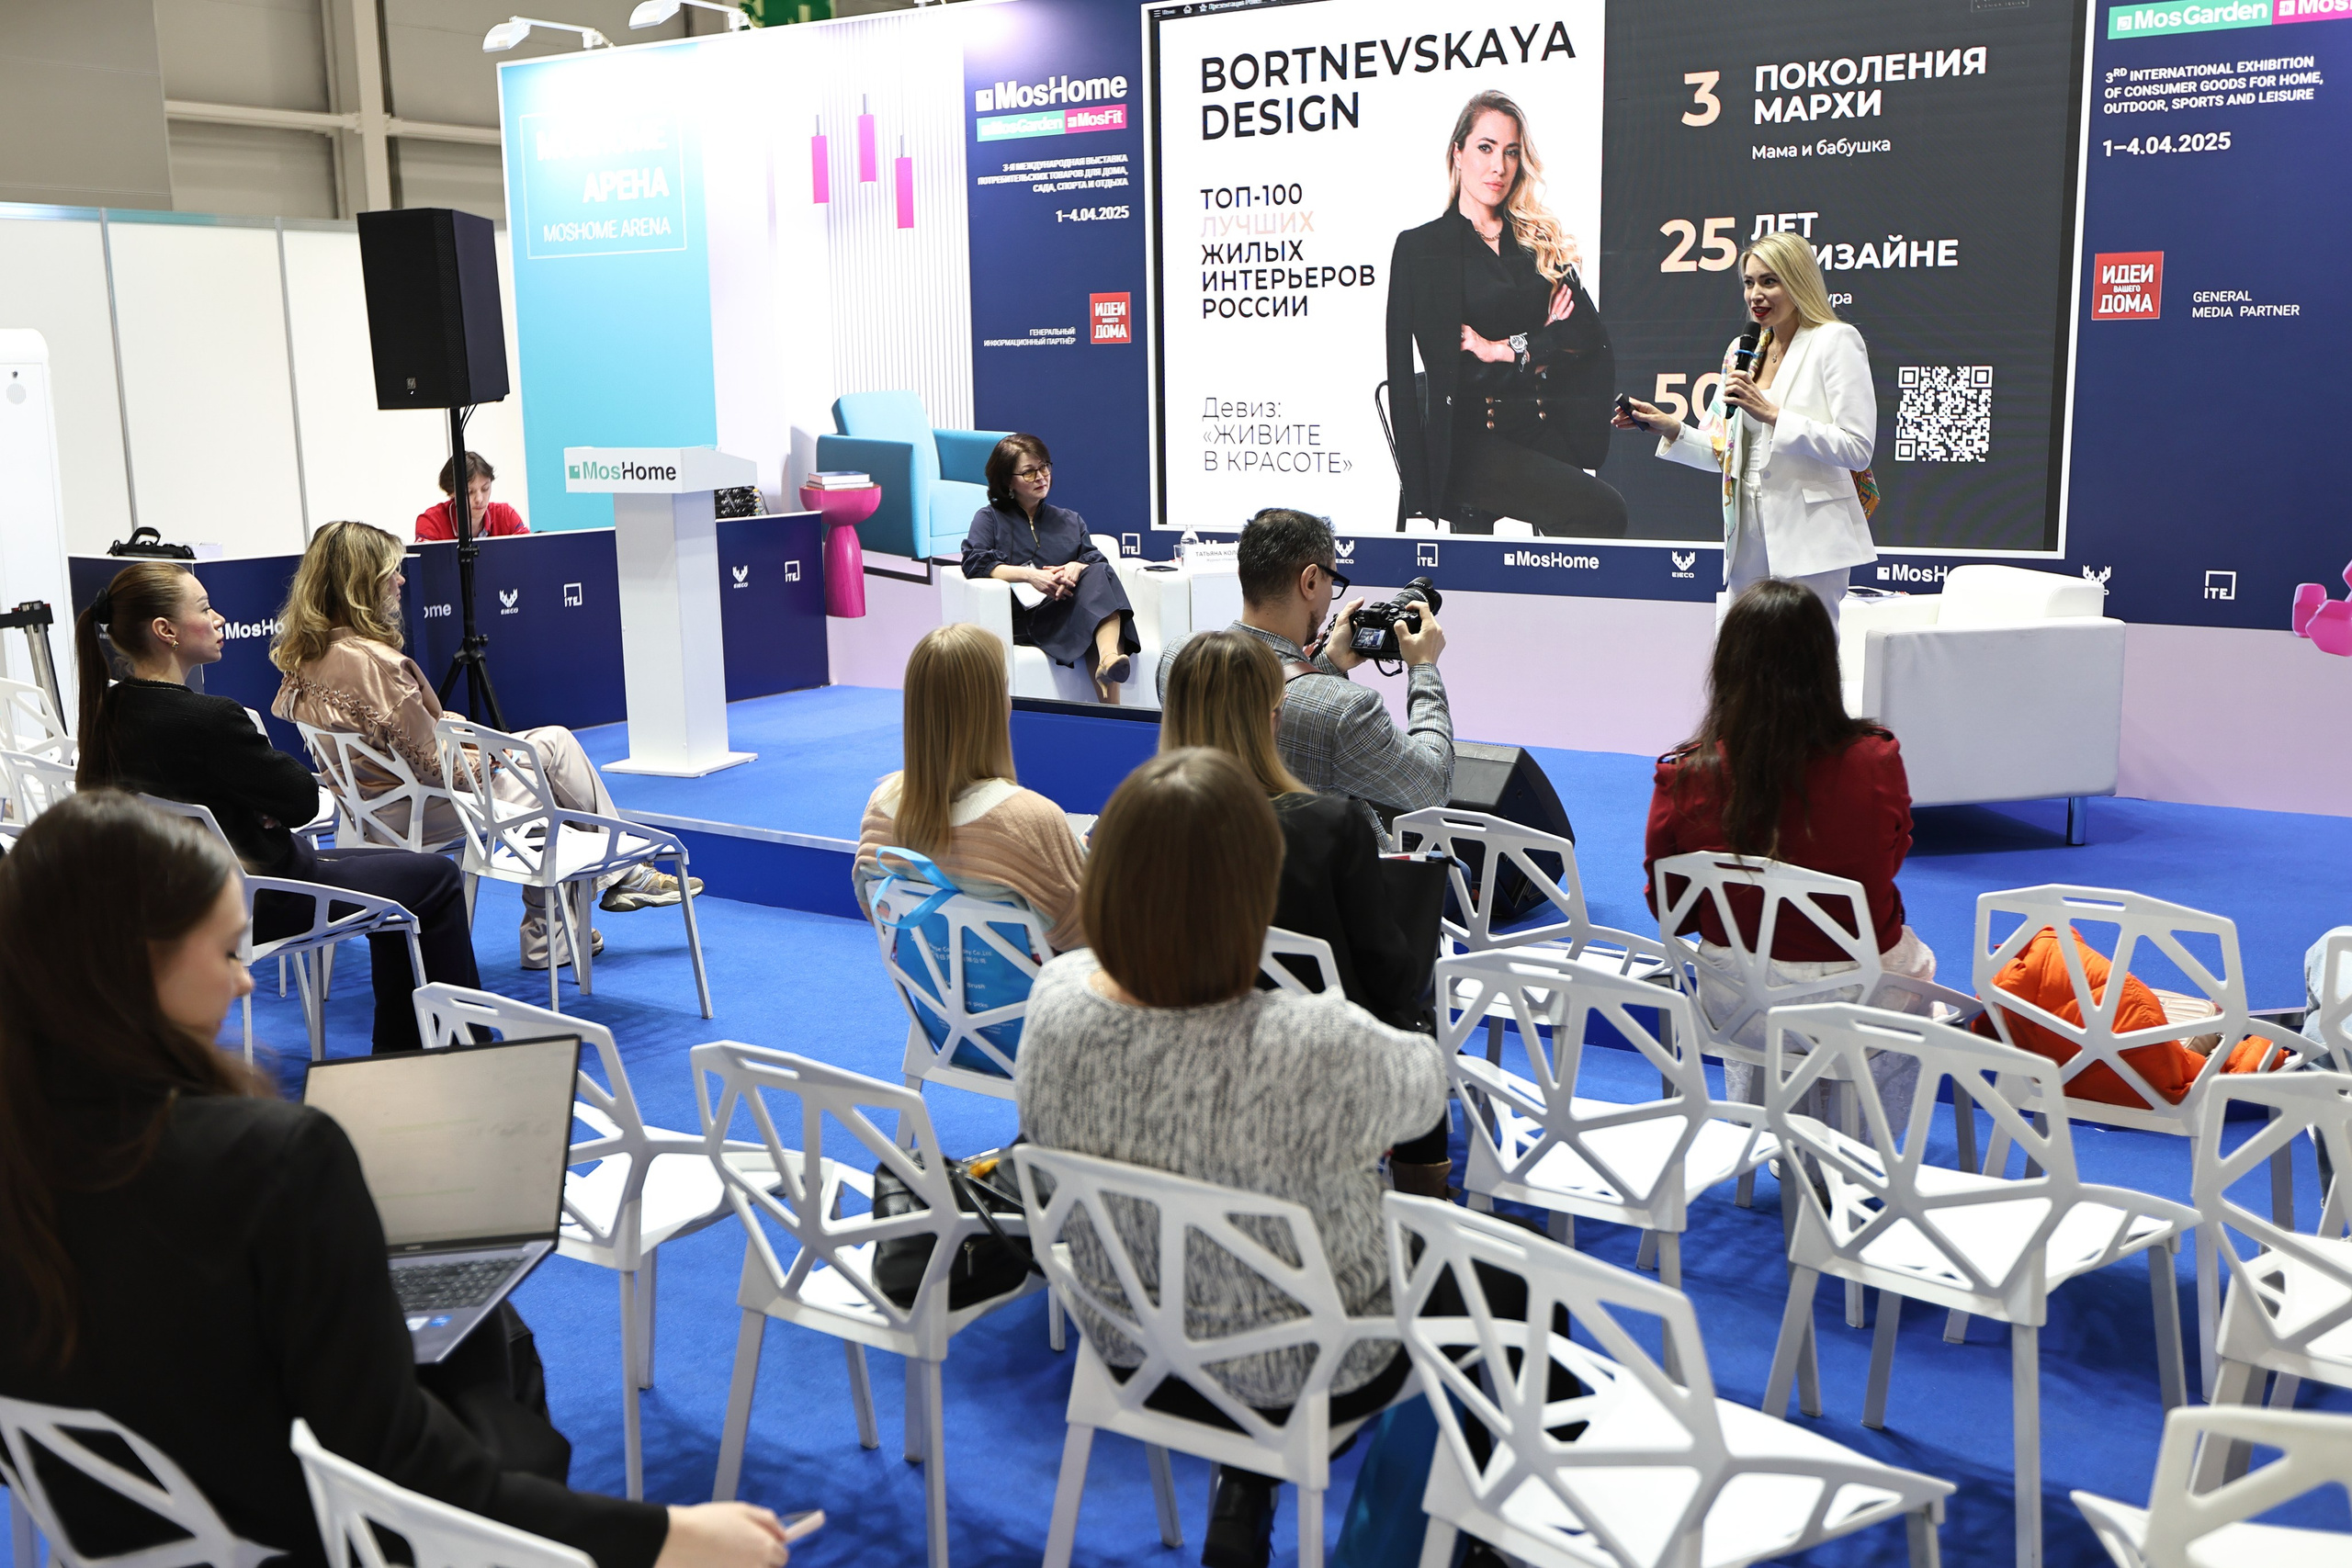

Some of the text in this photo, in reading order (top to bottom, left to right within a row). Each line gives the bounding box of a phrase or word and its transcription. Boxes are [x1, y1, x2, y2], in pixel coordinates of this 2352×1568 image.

[2134, 0, 2352, 29] MosGarden Mos
[1201, 21, 1577, 93] BORTNEVSKAYA
[2130, 63, 2234, 81] INTERNATIONAL
[2236, 56, 2314, 73] EXHIBITION
[995, 75, 1127, 109] MosHome
[1681, 46, 1987, 127] 3 ПОКОЛЕНИЯ
[2104, 71, 2324, 99] OF CONSUMER GOODS FOR HOME,
[1754, 89, 1882, 125] МАРХИ
[2103, 88, 2314, 115] OUTDOOR, SPORTS AND LEISURE
[1078, 110, 1123, 127] MosFit
[1202, 92, 1359, 141] DESIGN
[1015, 158, 1086, 171] МЕЖДУНАРОДНАЯ
[1086, 154, 1128, 164] ВЫСТАВКА
[1751, 137, 1891, 164] Мама и бабушка
[582, 166, 670, 203] АРЕНА
[978, 166, 1128, 185] ПОТРЕБИТЕЛЬСКИХ ТОВАРОВ ДЛЯ ДОМА,
[1033, 177, 1129, 194] САДА, СПОРТА И ОТДЫХА
[1200, 183, 1303, 209] ТОП-100
[543, 216, 672, 243] MOSHOME ARENA
[1200, 210, 1315, 238] ЛУЧШИХ
[1202, 240, 1304, 265] ЖИЛЫХ
[1659, 212, 1819, 273] 25 ЛЕТ
[1811, 234, 1959, 272] ИЗАЙНЕ
[1203, 265, 1375, 292] ИНТЕРЬЕРОВ
[2102, 264, 2154, 284] ИДЕИ
[2113, 285, 2141, 293] ВАШЕГО
[2193, 290, 2252, 303] GENERAL
[1094, 301, 1125, 317] ИДЕИ
[1203, 295, 1308, 319] РОССИИ
[2098, 293, 2154, 313] ДОМА
[2192, 304, 2300, 319] MEDIA PARTNER
[984, 337, 1076, 347] ИНФОРМАЦИОННЫЙ ПАРТНЁР
[1029, 326, 1076, 336] ГЕНЕРАЛЬНЫЙ
[1094, 324, 1127, 339] ДОМА
[1203, 397, 1282, 422] Девиз:
[1203, 424, 1321, 446] «ЖИВИТЕ
[582, 461, 677, 480] MosHome
[1204, 451, 1352, 473] В КРАСОТЕ»
[1517, 550, 1600, 570] MosHome
[1893, 564, 1948, 582] MosH
